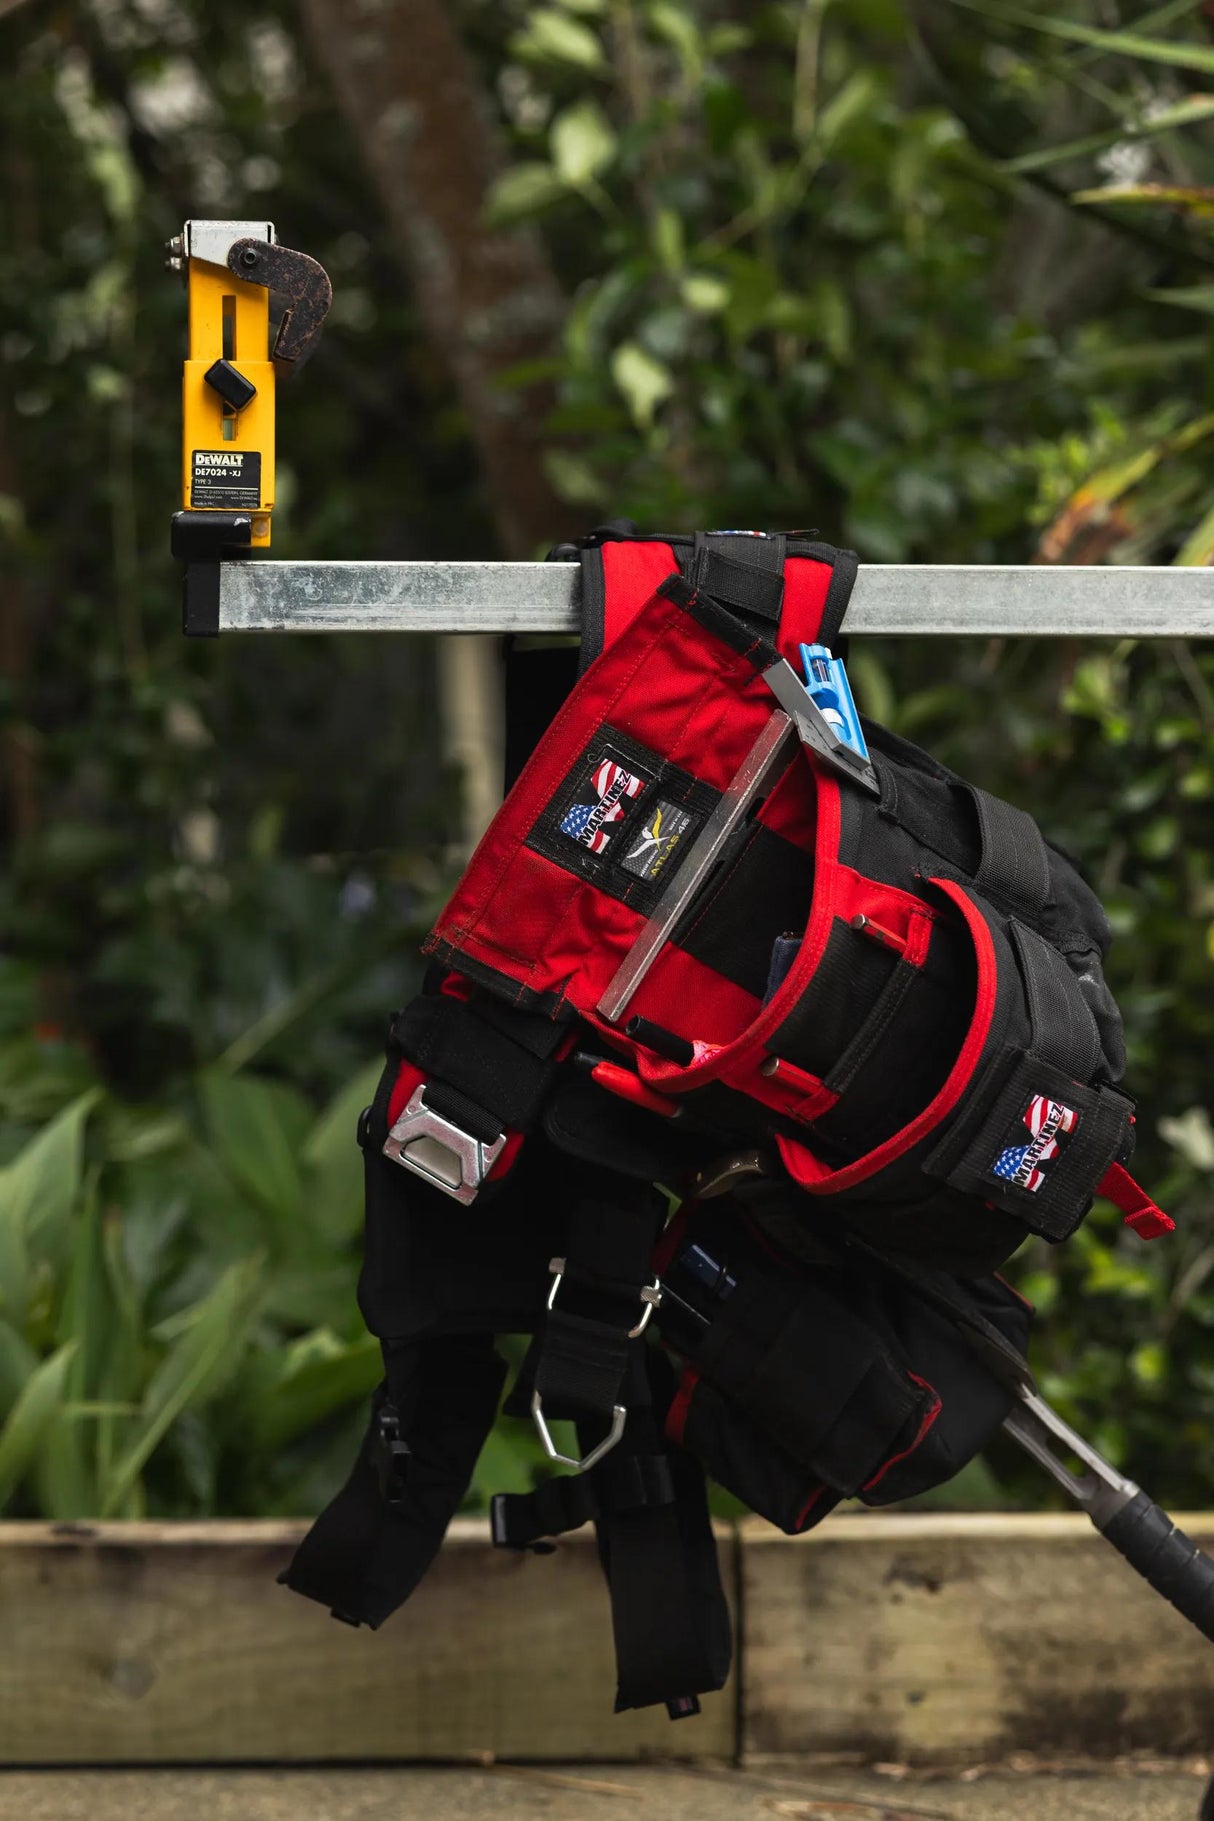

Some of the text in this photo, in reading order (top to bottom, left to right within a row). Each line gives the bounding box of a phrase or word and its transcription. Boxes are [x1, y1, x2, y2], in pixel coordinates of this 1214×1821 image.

[195, 468, 227, 476] DE7024
[578, 770, 630, 845] MARTINEZ
[651, 835, 679, 876] ATLAS
[1014, 1103, 1064, 1185] MARTINEZ
